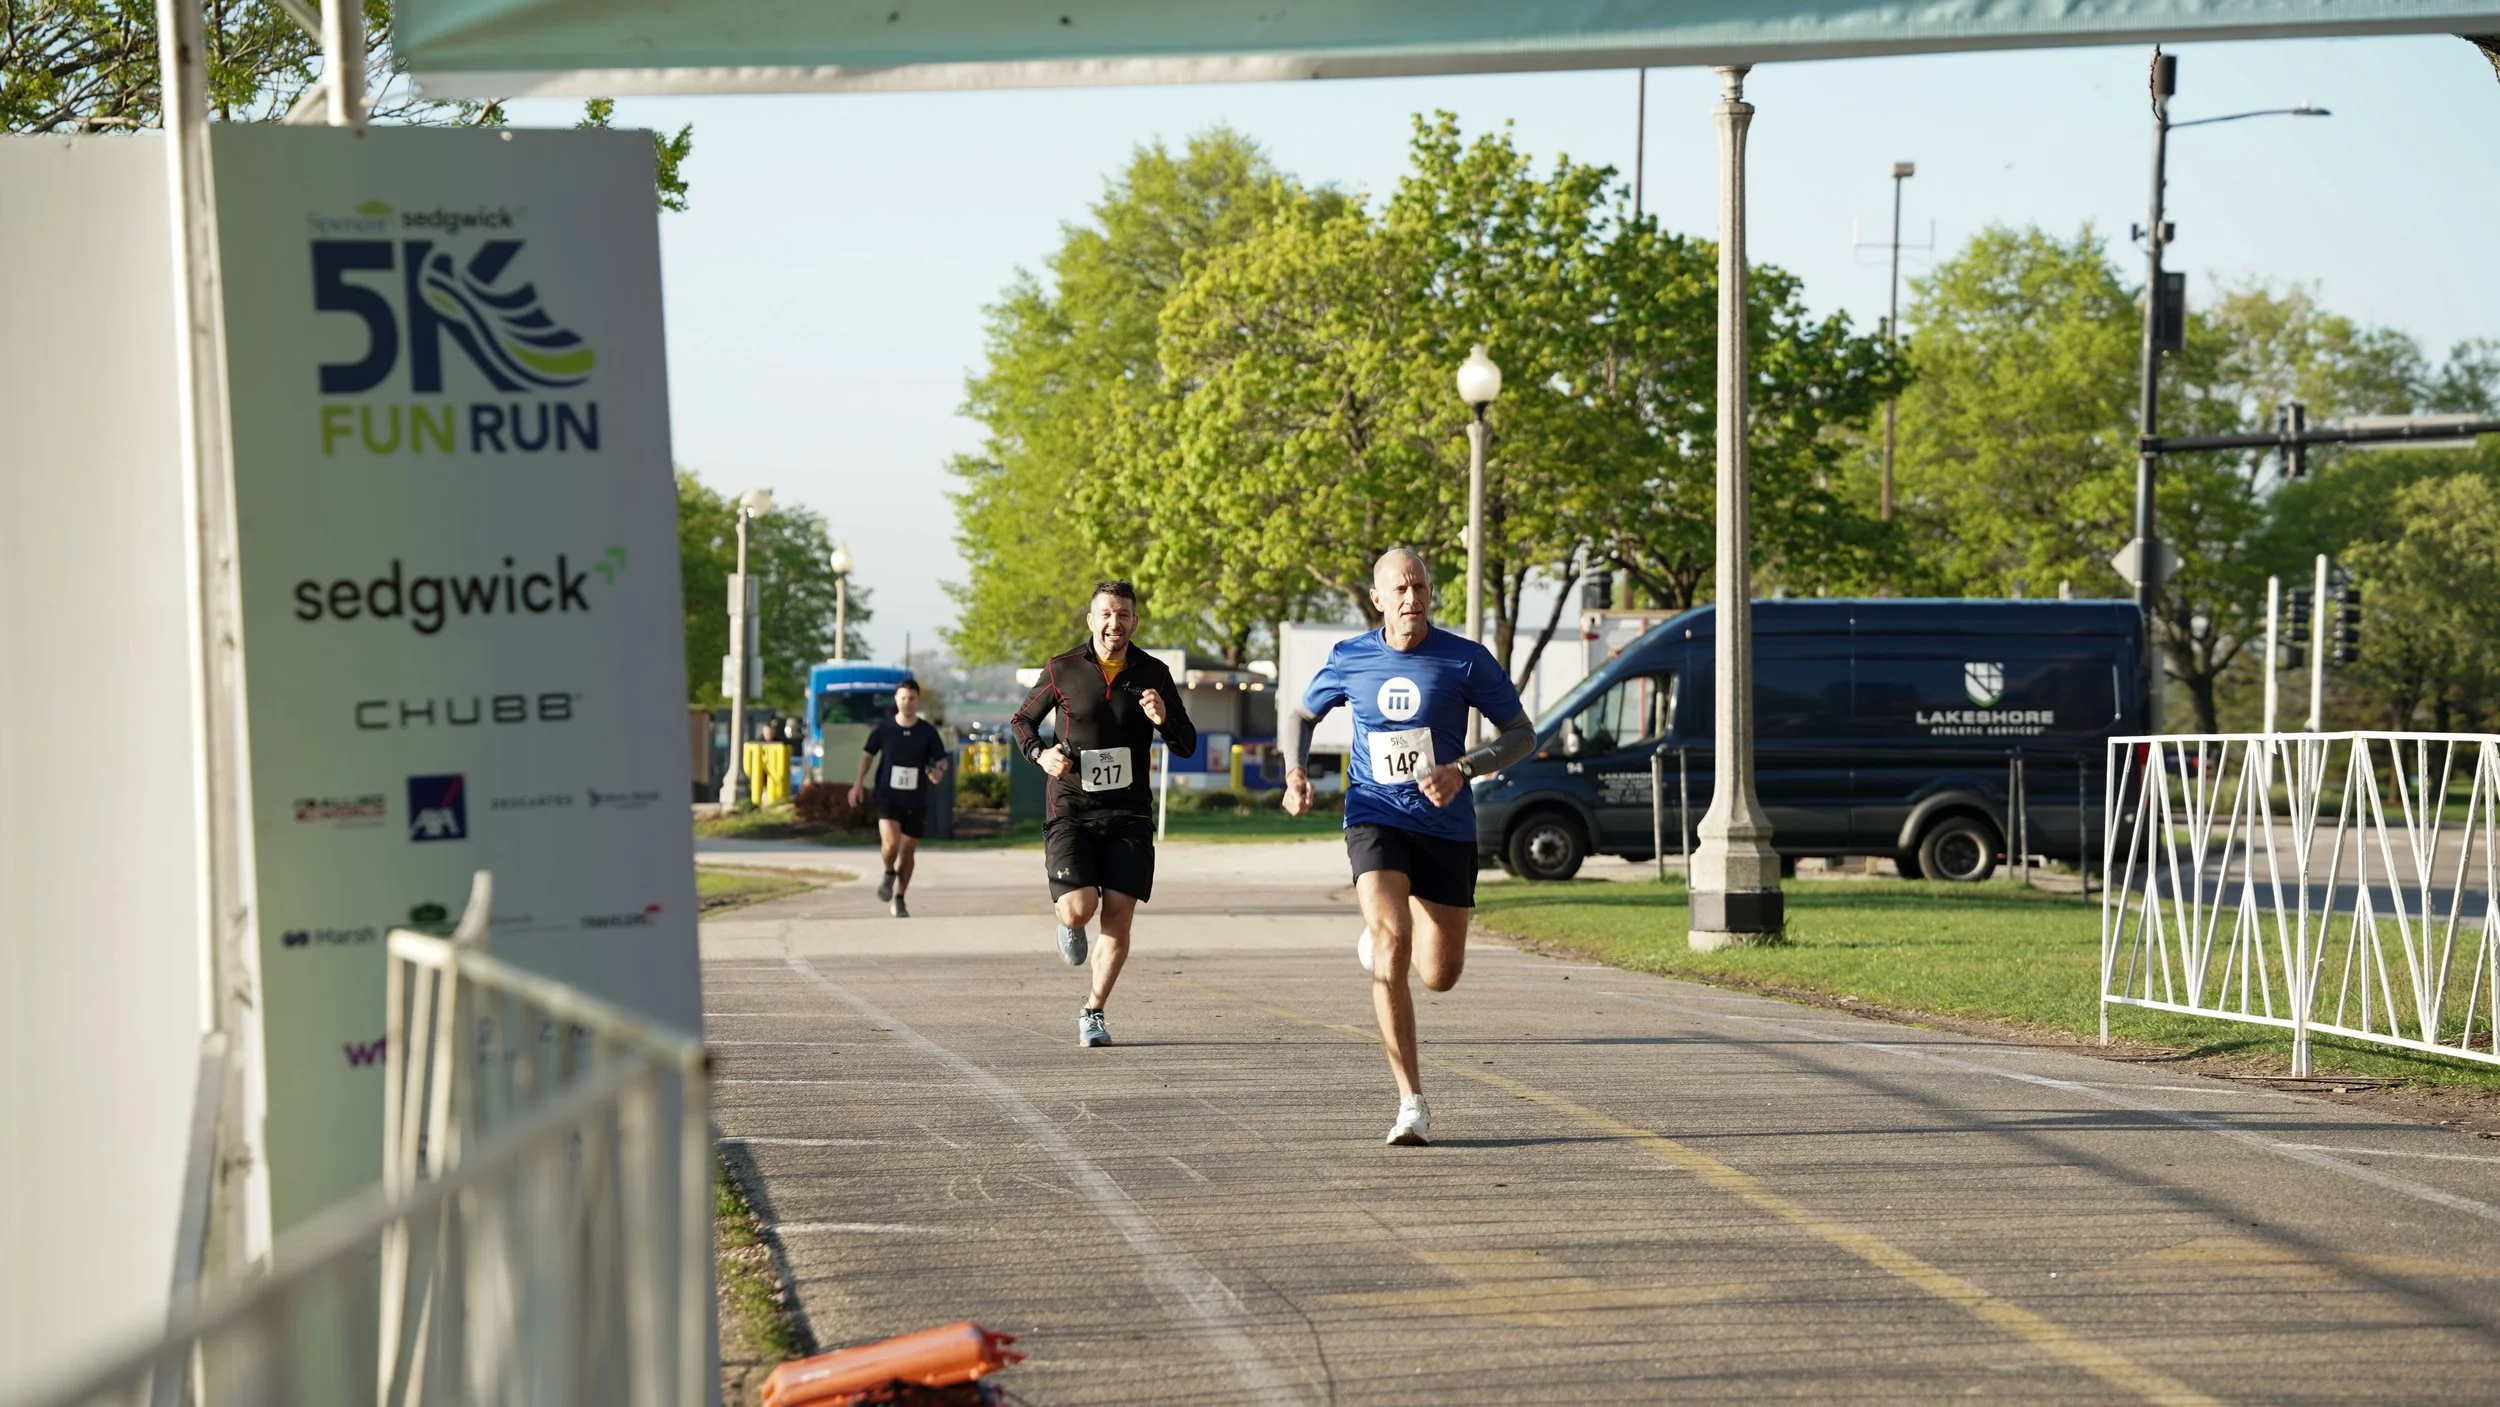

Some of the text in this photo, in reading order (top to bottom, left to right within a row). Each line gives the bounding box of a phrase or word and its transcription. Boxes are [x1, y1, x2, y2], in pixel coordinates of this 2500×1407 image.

[402, 206, 512, 235] sedgwick
[309, 239, 596, 395] 5K
[319, 401, 601, 456] FUN RUN
[294, 554, 590, 636] sedgwick
[355, 692, 574, 731] CHUBB
[1915, 709, 2055, 725] LAKESHORE
[1092, 764, 1122, 786] 217
[1384, 750, 1419, 777] 148
[409, 807, 462, 838] AXA
